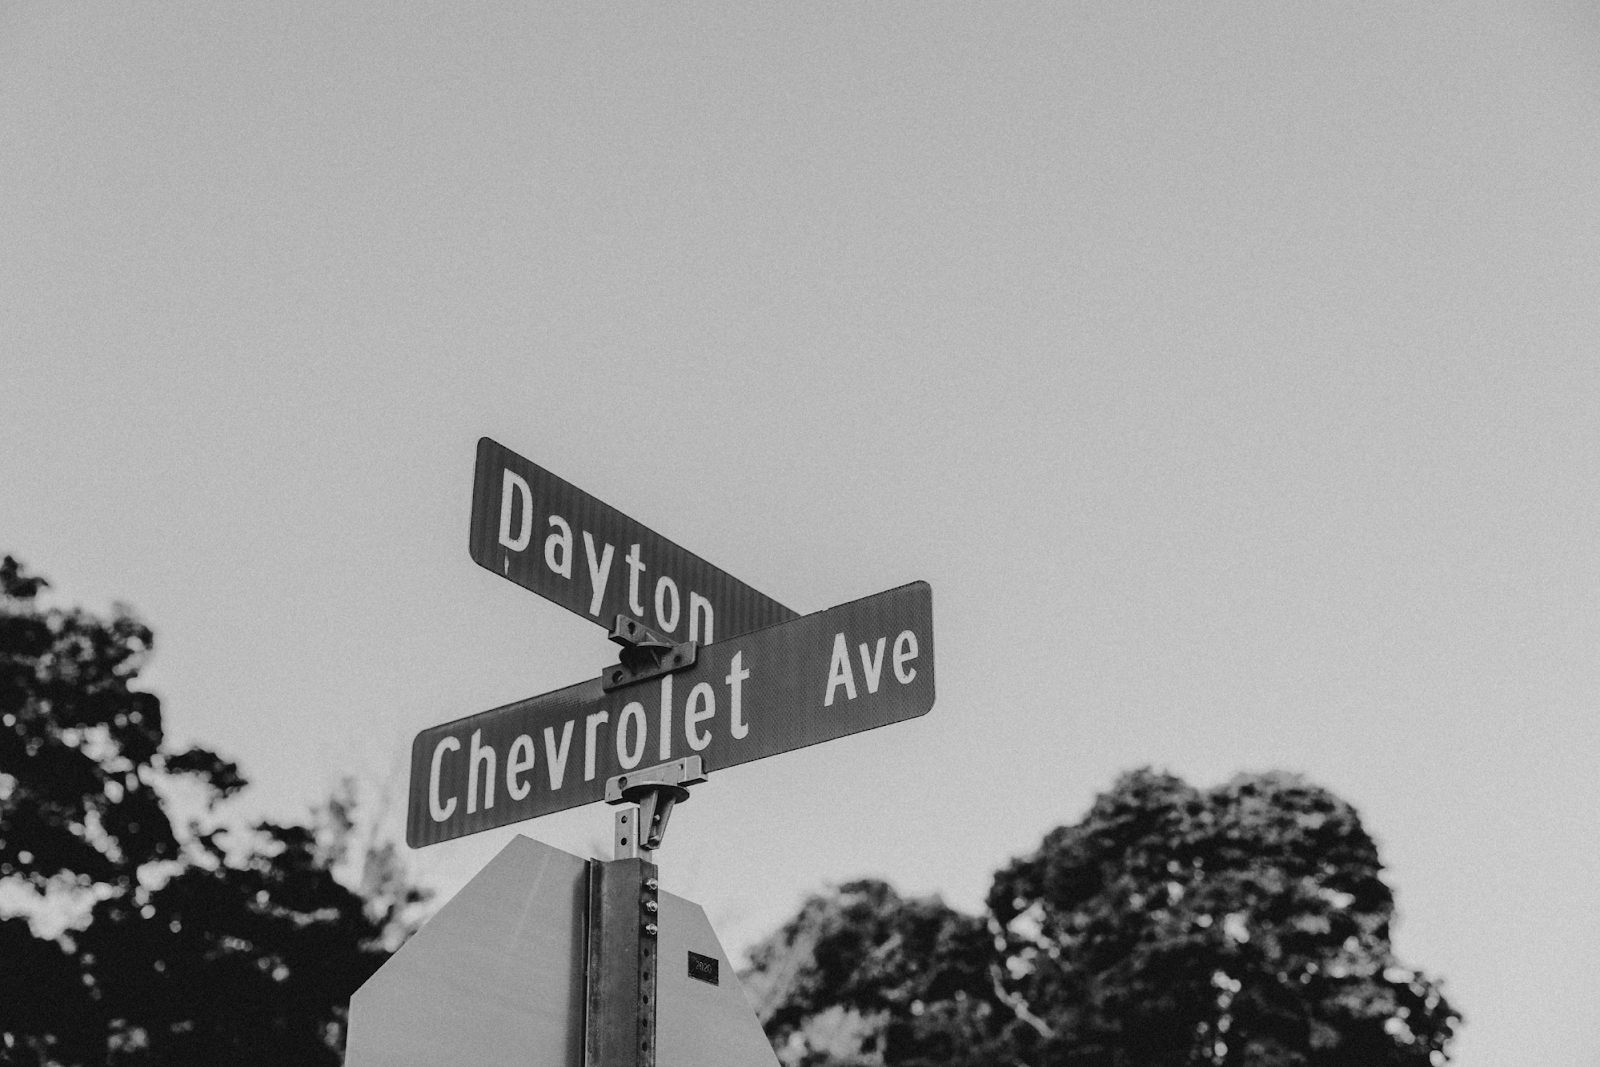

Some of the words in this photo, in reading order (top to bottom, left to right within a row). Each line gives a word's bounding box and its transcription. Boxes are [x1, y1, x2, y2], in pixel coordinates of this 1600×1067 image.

[498, 467, 715, 646] Dayton
[428, 650, 750, 823] Chevrolet
[823, 629, 919, 707] Ave
[695, 960, 712, 974] 2020
